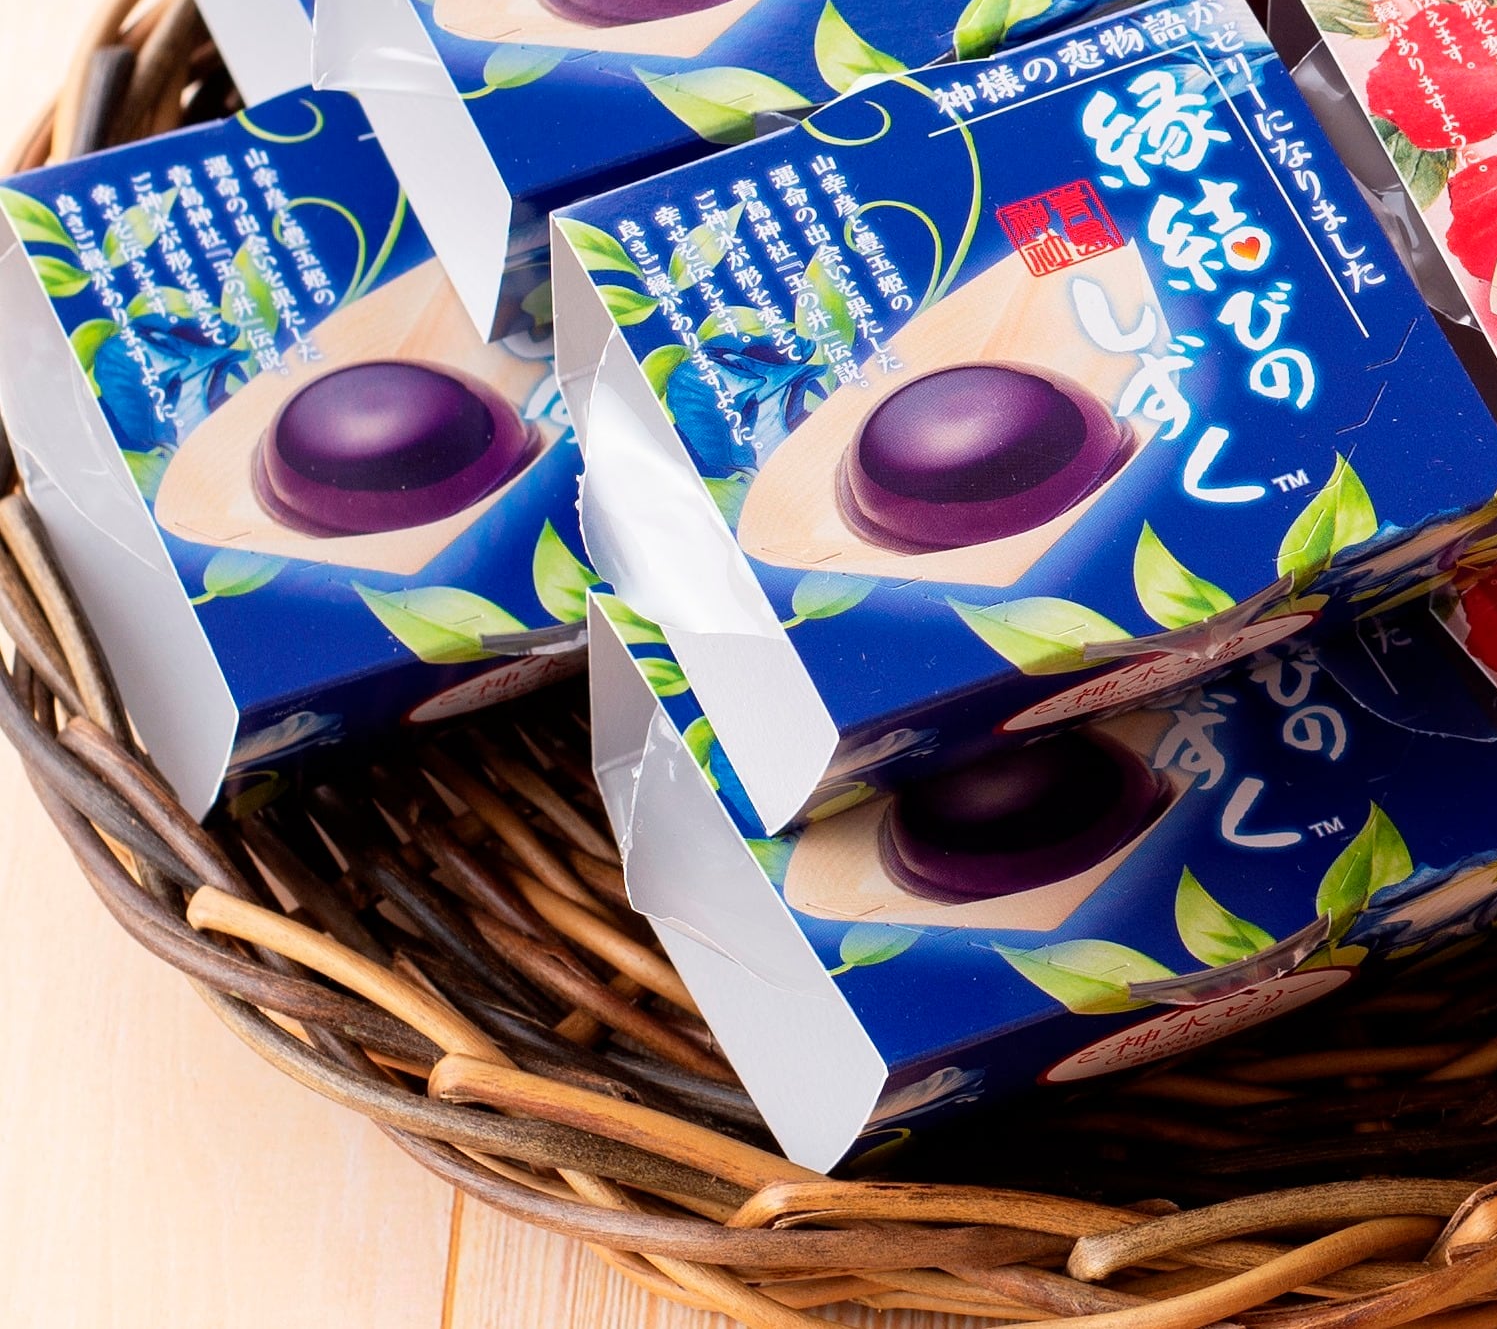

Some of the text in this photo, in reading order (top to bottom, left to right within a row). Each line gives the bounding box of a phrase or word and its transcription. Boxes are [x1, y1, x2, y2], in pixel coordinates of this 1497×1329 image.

[811, 154, 914, 313] 山幸彦と豊玉姫の
[1081, 69, 1317, 411] 縁結びの
[1207, 21, 1388, 295] ゼリーになりました
[654, 204, 752, 345] 幸せを伝えます。
[694, 188, 804, 363] ご神水が形を変えて
[769, 162, 905, 376] 運命の出会いを果たした
[1071, 275, 1311, 504] しずく TM
[1152, 690, 1346, 849] ずく TM
[1077, 979, 1327, 1065] ご神水ゼリー
